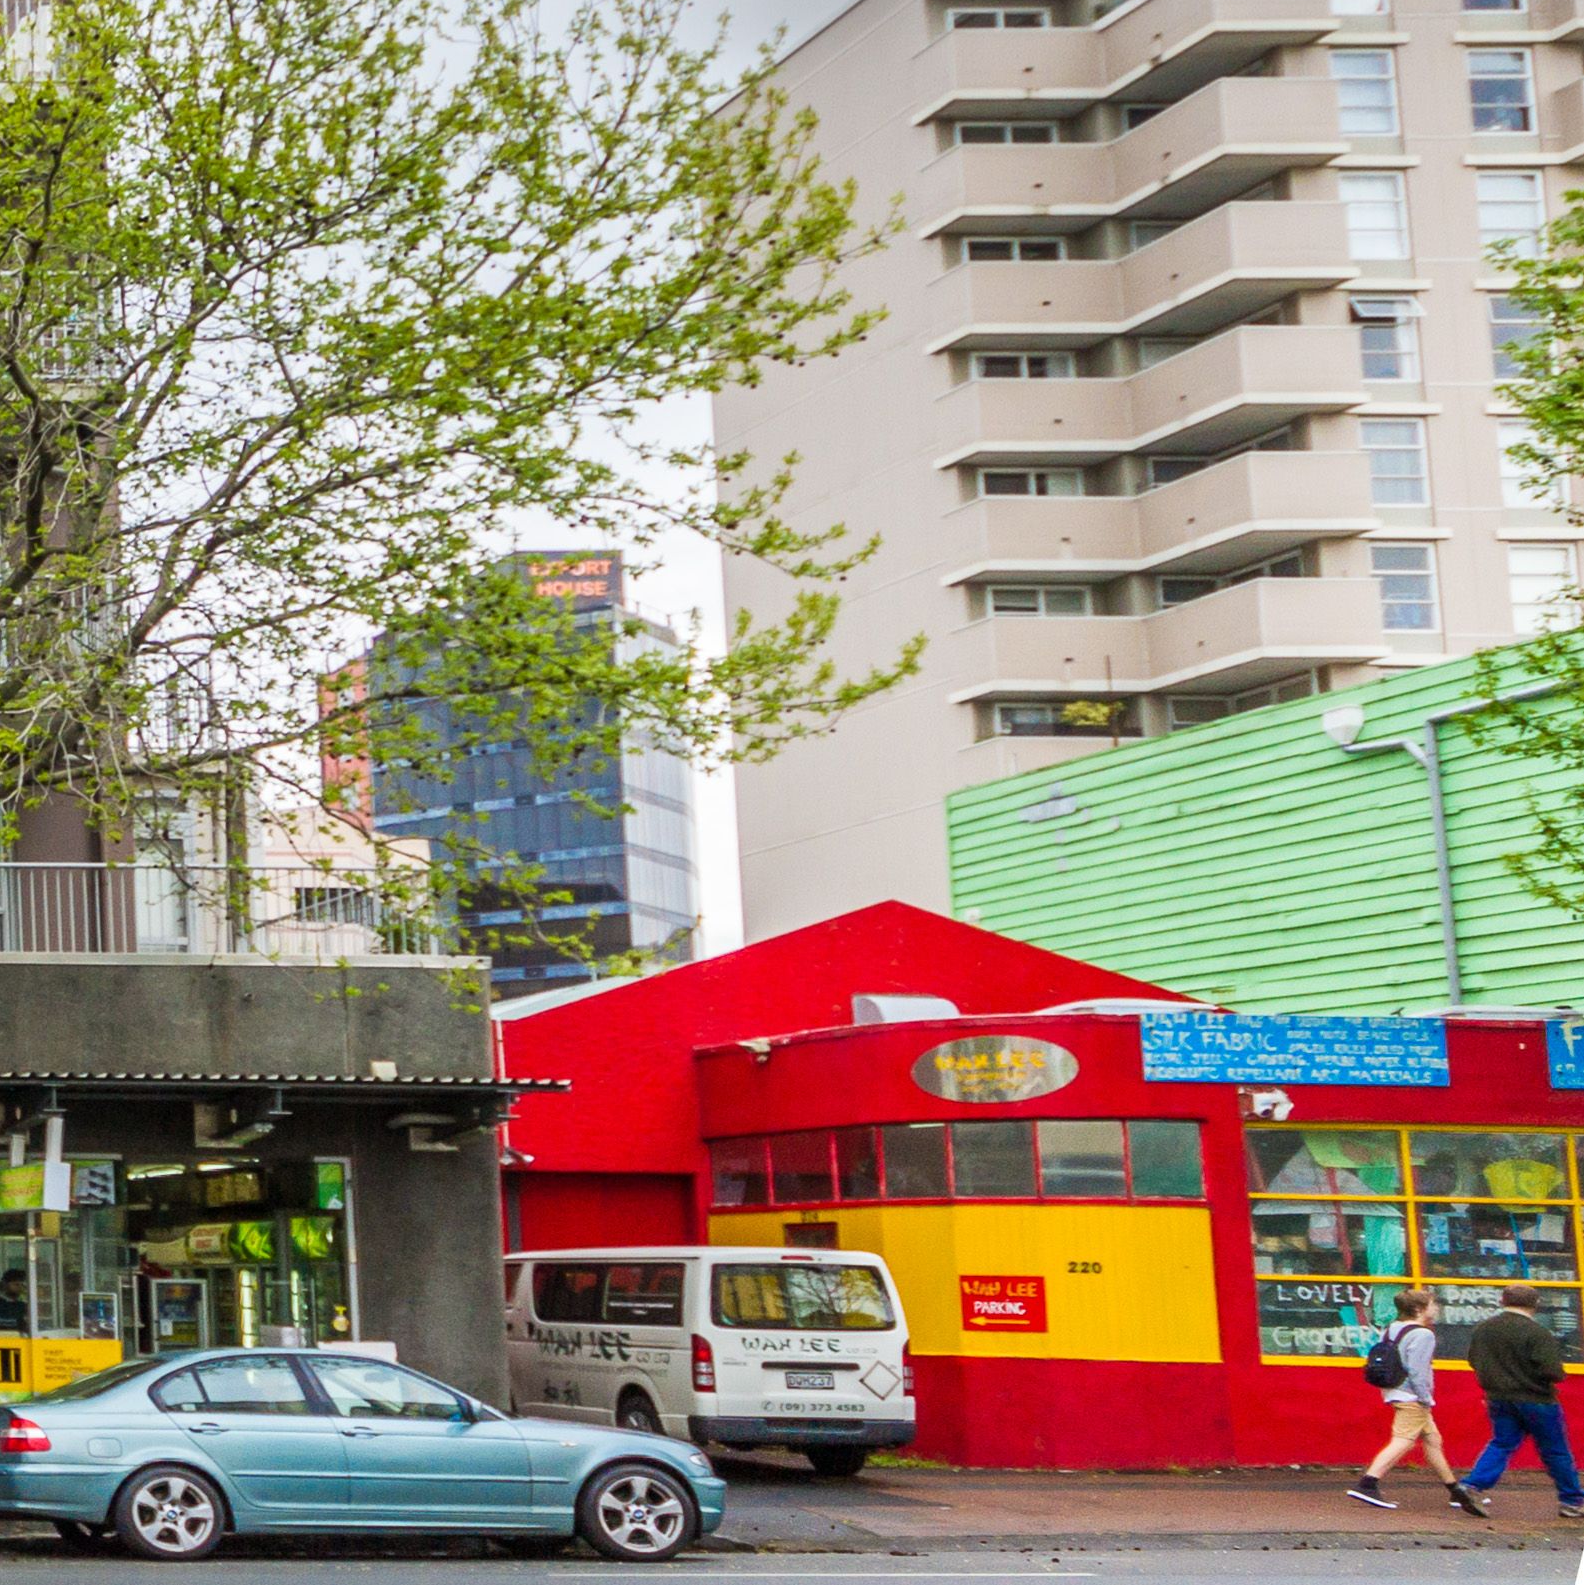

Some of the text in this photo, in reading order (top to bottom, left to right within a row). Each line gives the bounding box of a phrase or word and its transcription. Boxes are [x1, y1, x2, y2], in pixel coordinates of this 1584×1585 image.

[535, 580, 608, 597] HOUSE
[1141, 1030, 1278, 1052] SILK FABRIC
[1067, 1261, 1103, 1274] 220
[1005, 1281, 1039, 1298] LEE
[1276, 1284, 1373, 1306] LOVELY
[972, 1299, 1027, 1316] PARKING
[800, 1337, 841, 1354] LEE
[787, 1374, 832, 1387] DQH237
[779, 1402, 866, 1413] (09) 373 4583
